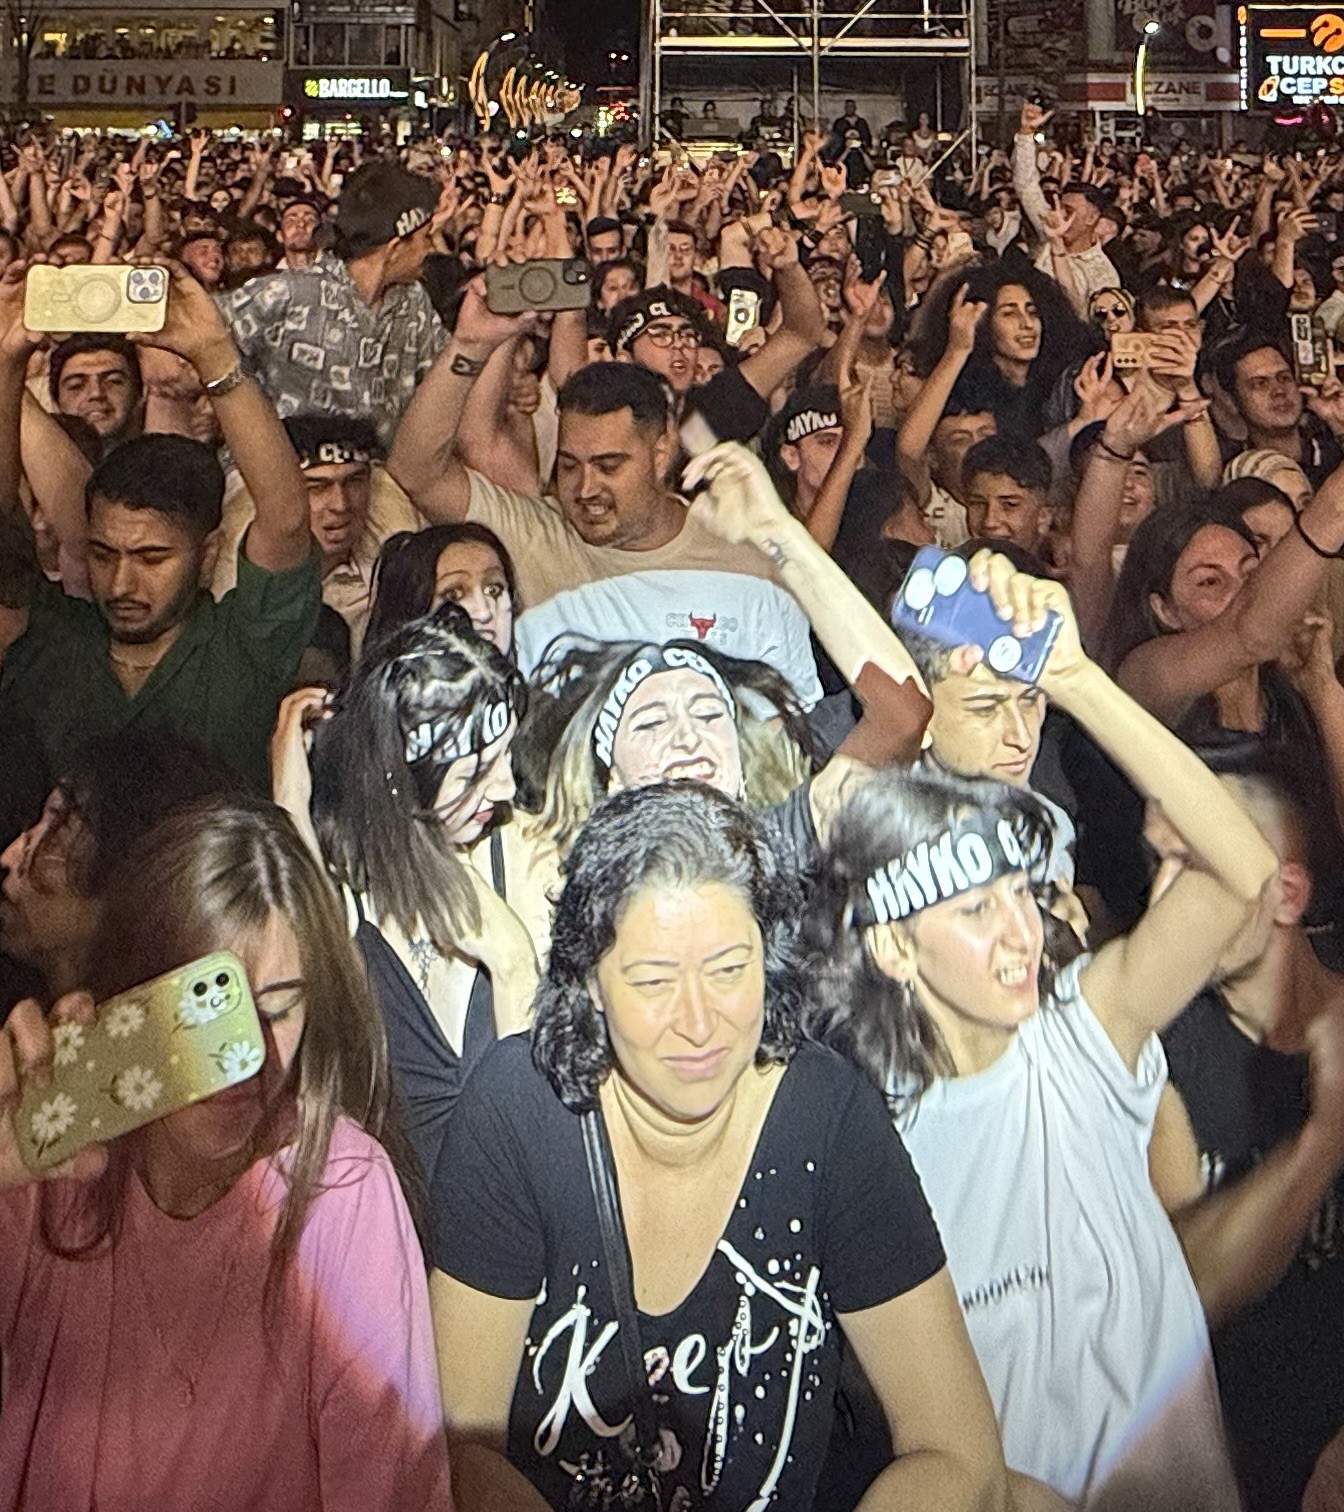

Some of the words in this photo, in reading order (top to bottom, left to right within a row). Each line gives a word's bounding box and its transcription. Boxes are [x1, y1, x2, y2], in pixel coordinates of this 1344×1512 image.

[73, 68, 236, 95] DÜNYASI
[319, 79, 390, 97] BARGELLO
[1280, 78, 1328, 94] CEP
[867, 831, 992, 925] HAYKO
